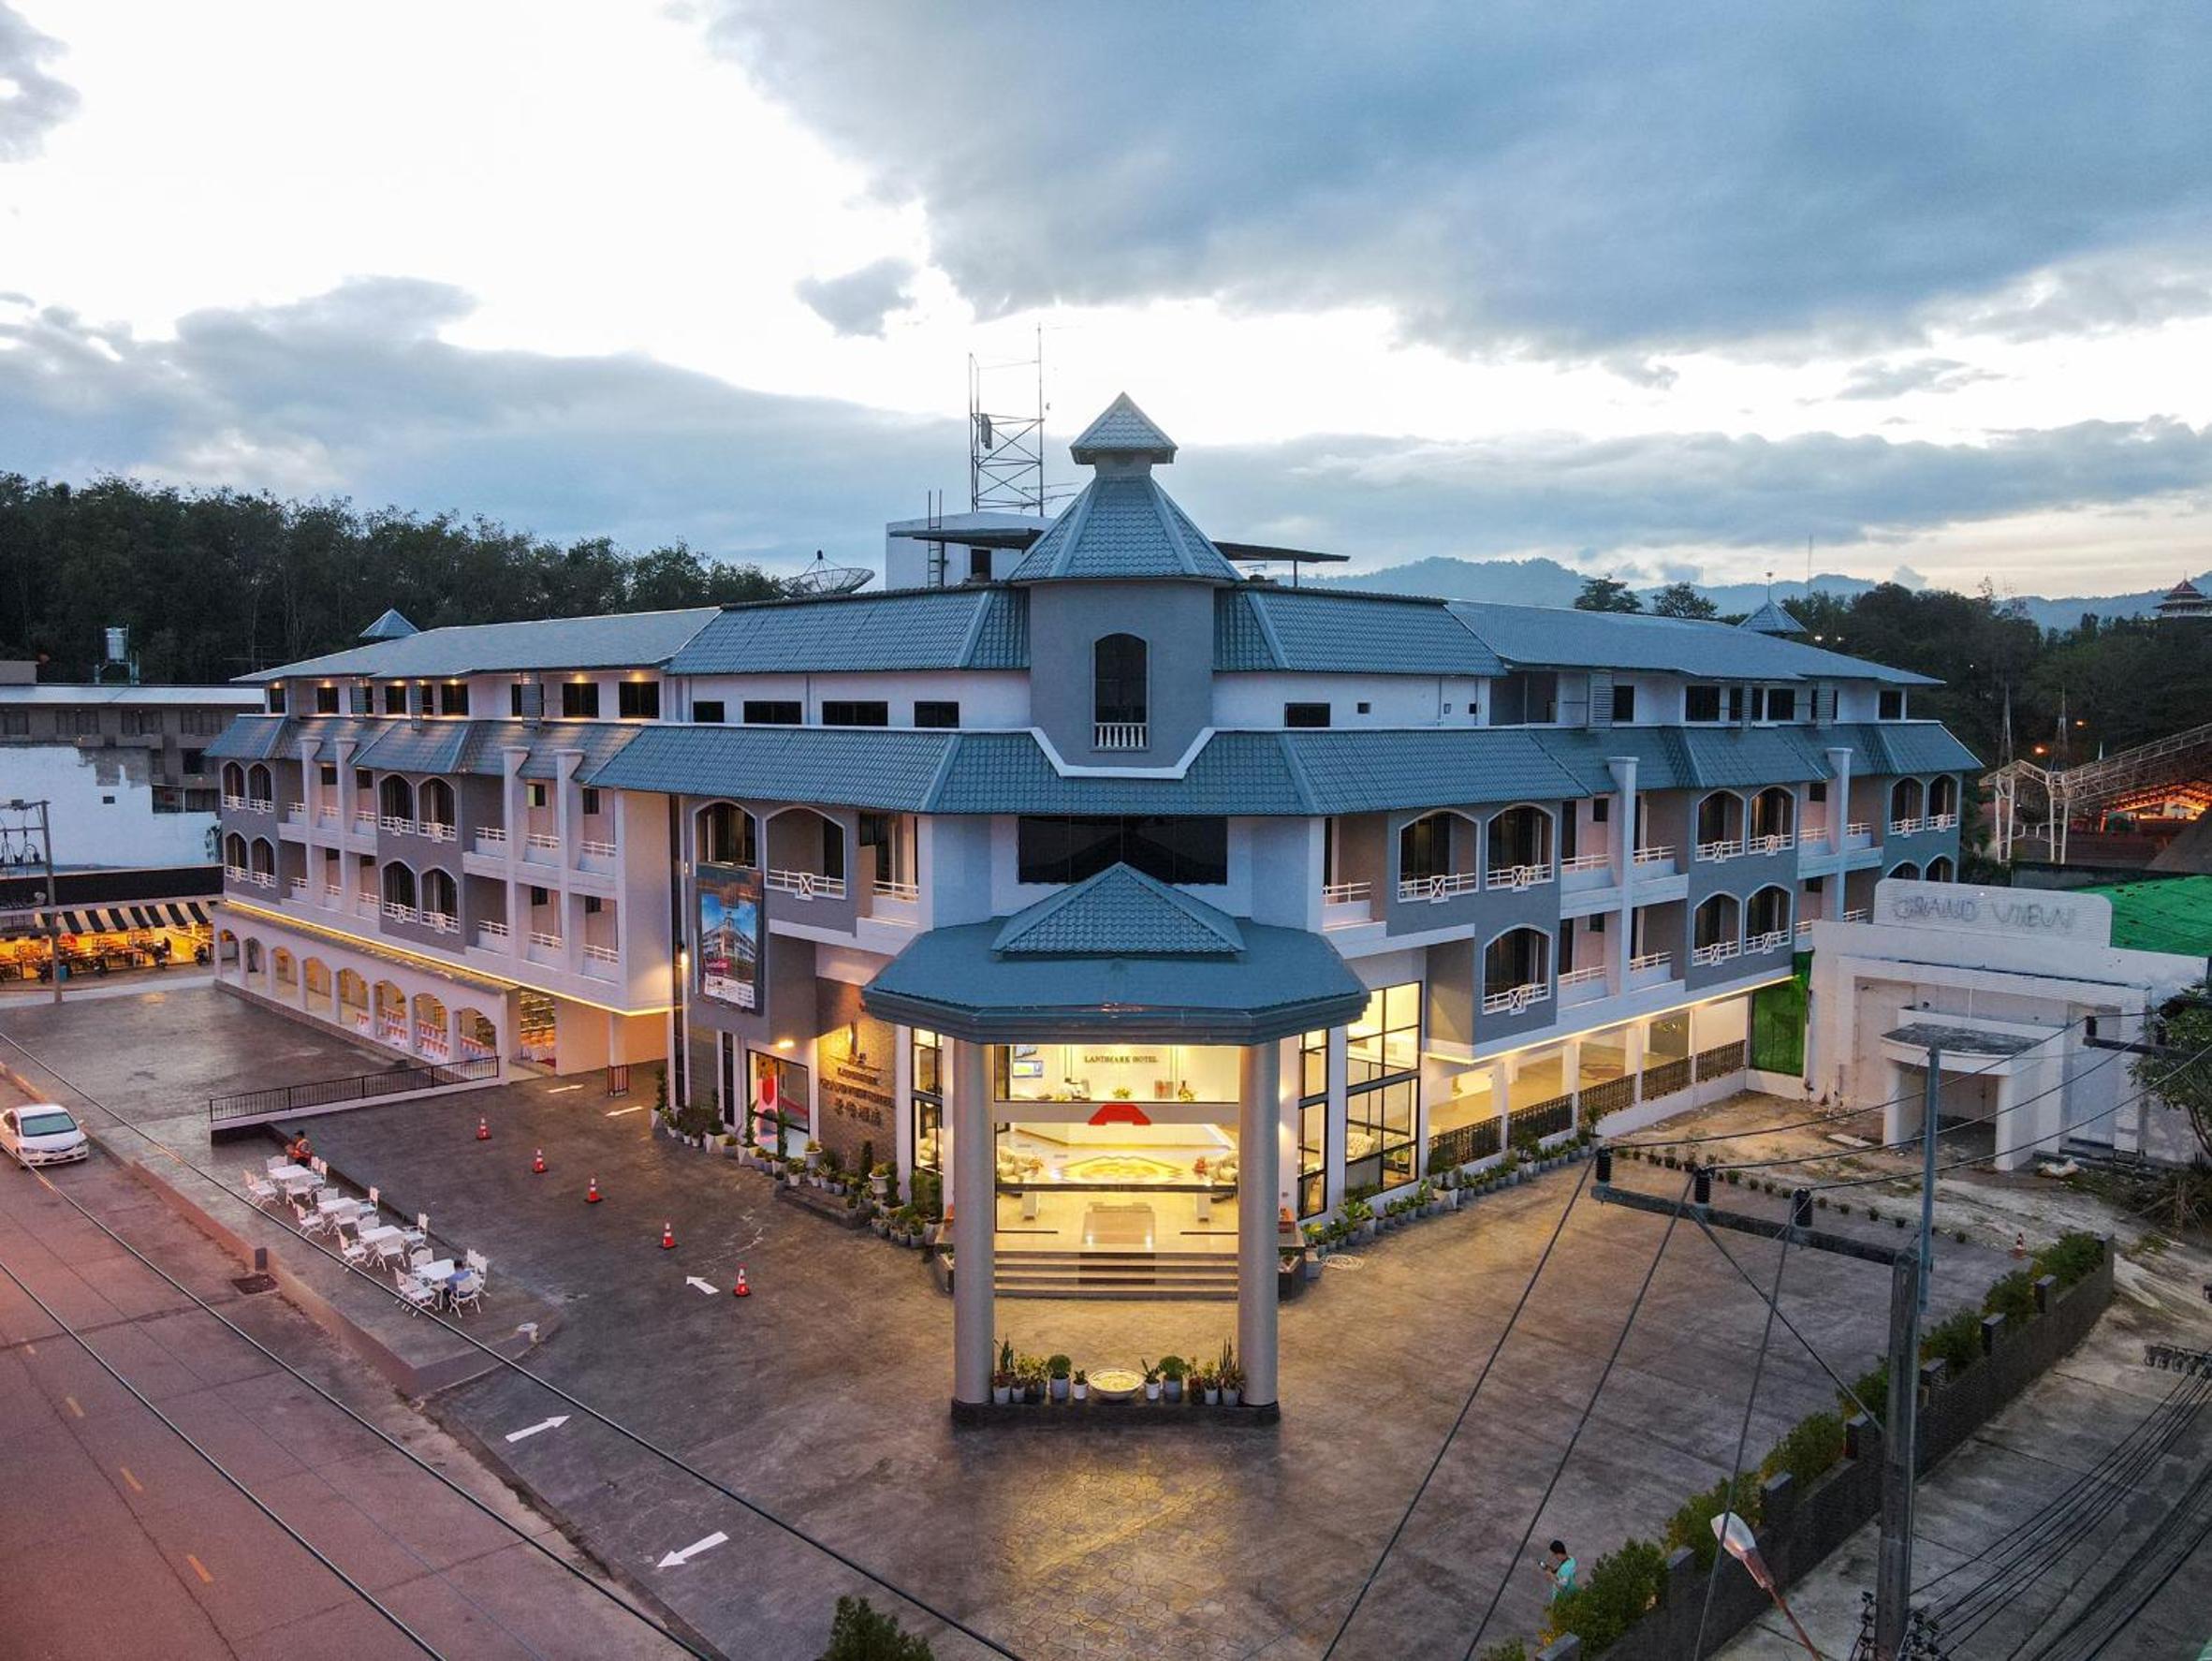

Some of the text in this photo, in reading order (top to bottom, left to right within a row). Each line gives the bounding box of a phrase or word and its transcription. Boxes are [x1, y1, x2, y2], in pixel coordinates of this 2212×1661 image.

[1894, 896, 2076, 929] GRAND VIEW
[1084, 1055, 1159, 1064] LANDMARK HOTEL
